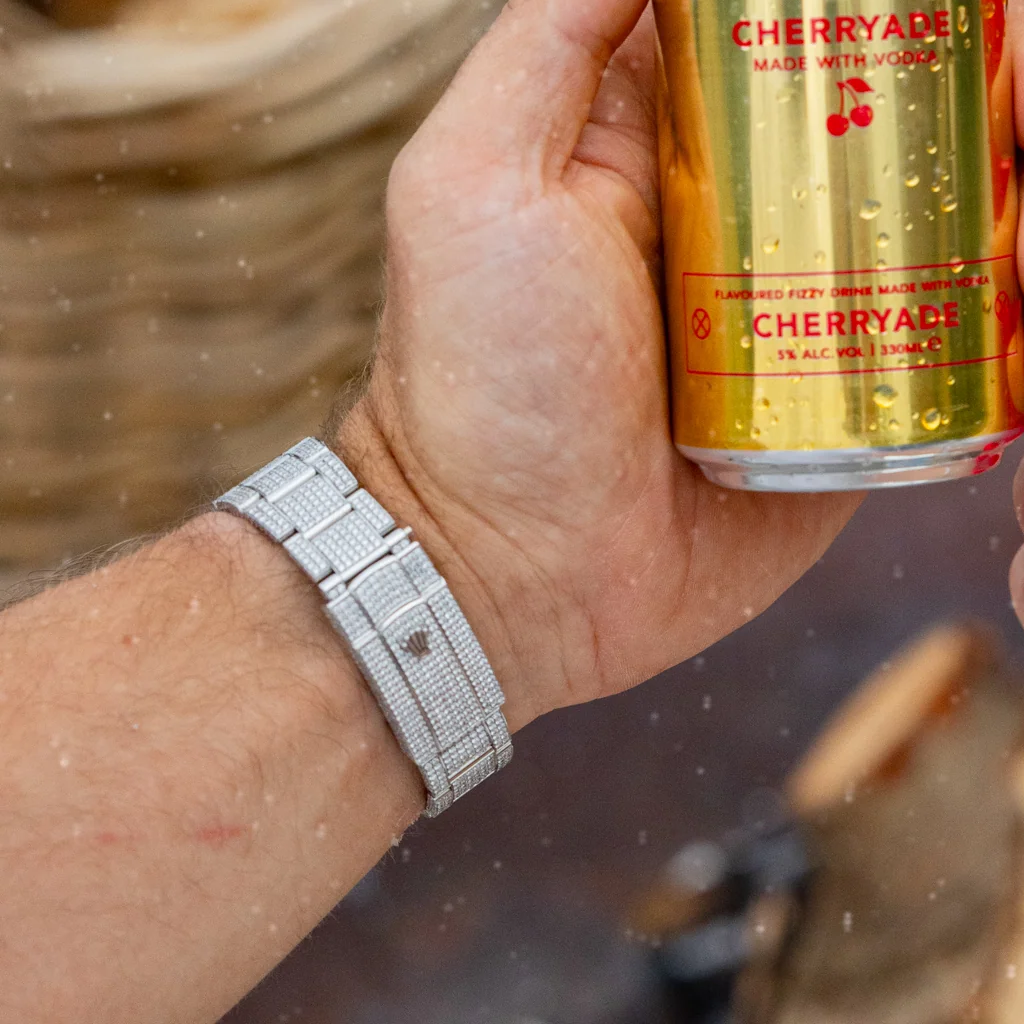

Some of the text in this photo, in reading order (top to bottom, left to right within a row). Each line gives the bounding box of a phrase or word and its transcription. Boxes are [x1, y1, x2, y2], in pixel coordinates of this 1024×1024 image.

[731, 10, 951, 48] CHERRYADE
[753, 49, 938, 72] MADE WITH VODKA
[715, 289, 784, 300] FLAVOURED
[788, 288, 825, 300] FIZZY
[831, 286, 873, 298] DRINK
[878, 282, 917, 295] MADE
[921, 279, 952, 292] WITH
[752, 301, 960, 338] CHERRYADE
[777, 349, 797, 360] 5%
[880, 343, 924, 356] 330ML
